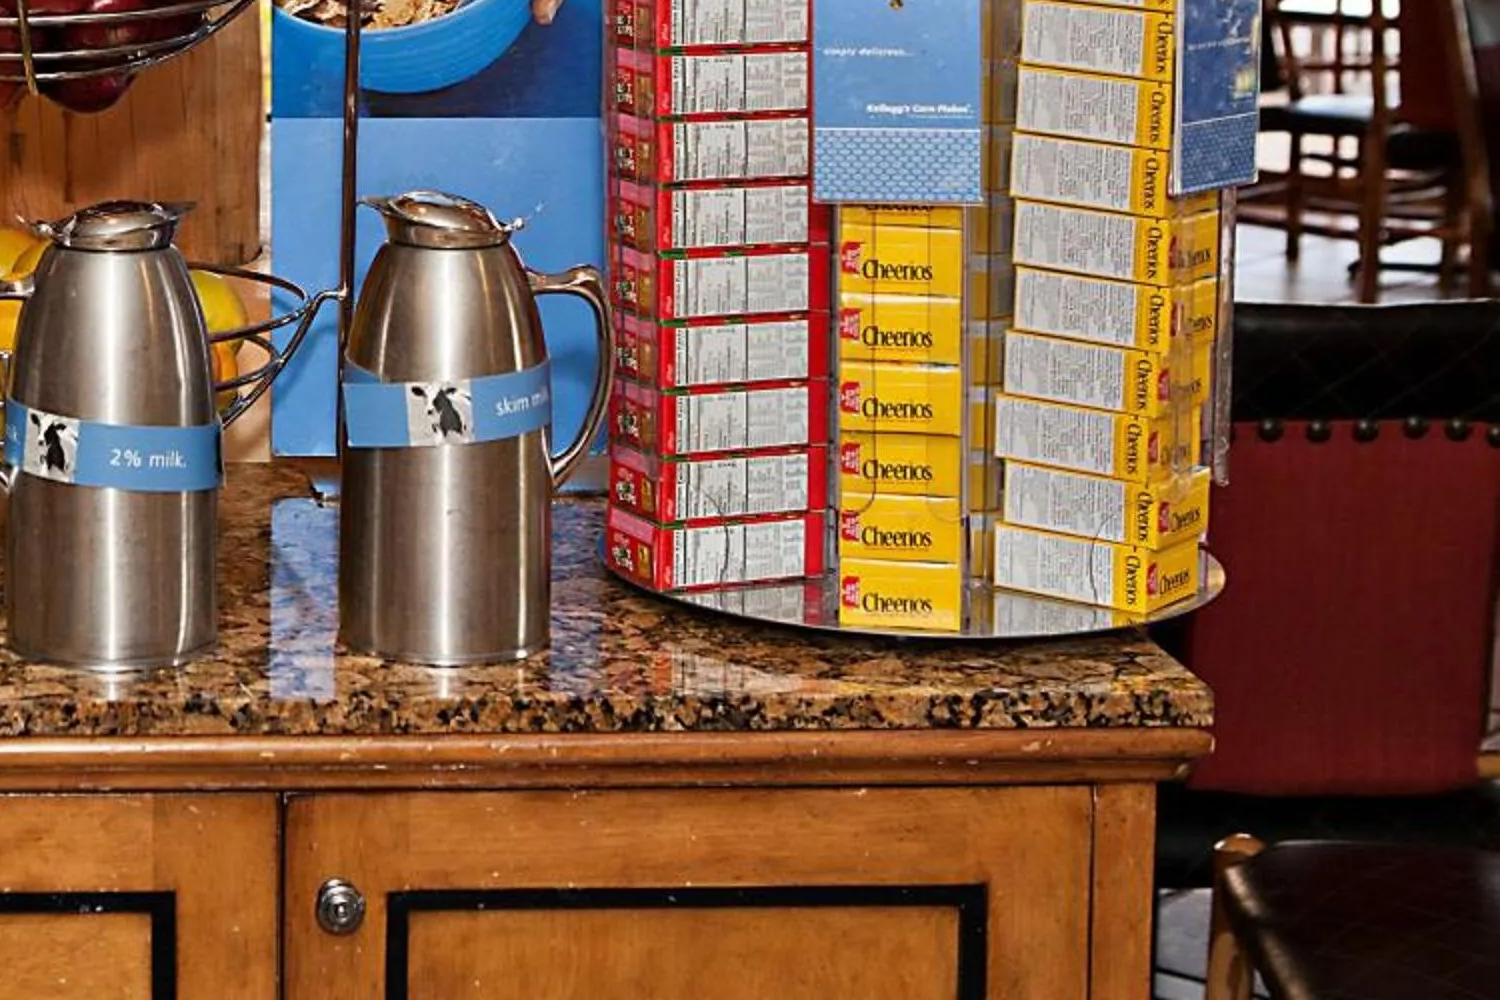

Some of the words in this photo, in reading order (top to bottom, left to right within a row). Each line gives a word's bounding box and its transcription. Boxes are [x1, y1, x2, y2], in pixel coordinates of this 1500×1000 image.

[1156, 21, 1174, 74] Cheerios
[1150, 91, 1166, 143] Cheerios
[1143, 158, 1160, 209] Cheerios
[862, 259, 933, 280] Cheerios
[1147, 226, 1163, 280] Cheerios
[862, 325, 933, 348] Cheerios
[1149, 295, 1165, 345] Cheerios
[496, 395, 529, 417] skim
[862, 396, 933, 419] Cheerios
[1137, 359, 1153, 410] Cheerios
[109, 447, 142, 468] 2%
[149, 447, 187, 469] milk.
[862, 459, 933, 480] Cheerios
[1127, 423, 1143, 475] Cheerios
[861, 525, 932, 547] Cheerios
[1137, 491, 1153, 542] Cheerios
[862, 591, 933, 613] Cheerios
[1125, 555, 1141, 605] Cheerios
